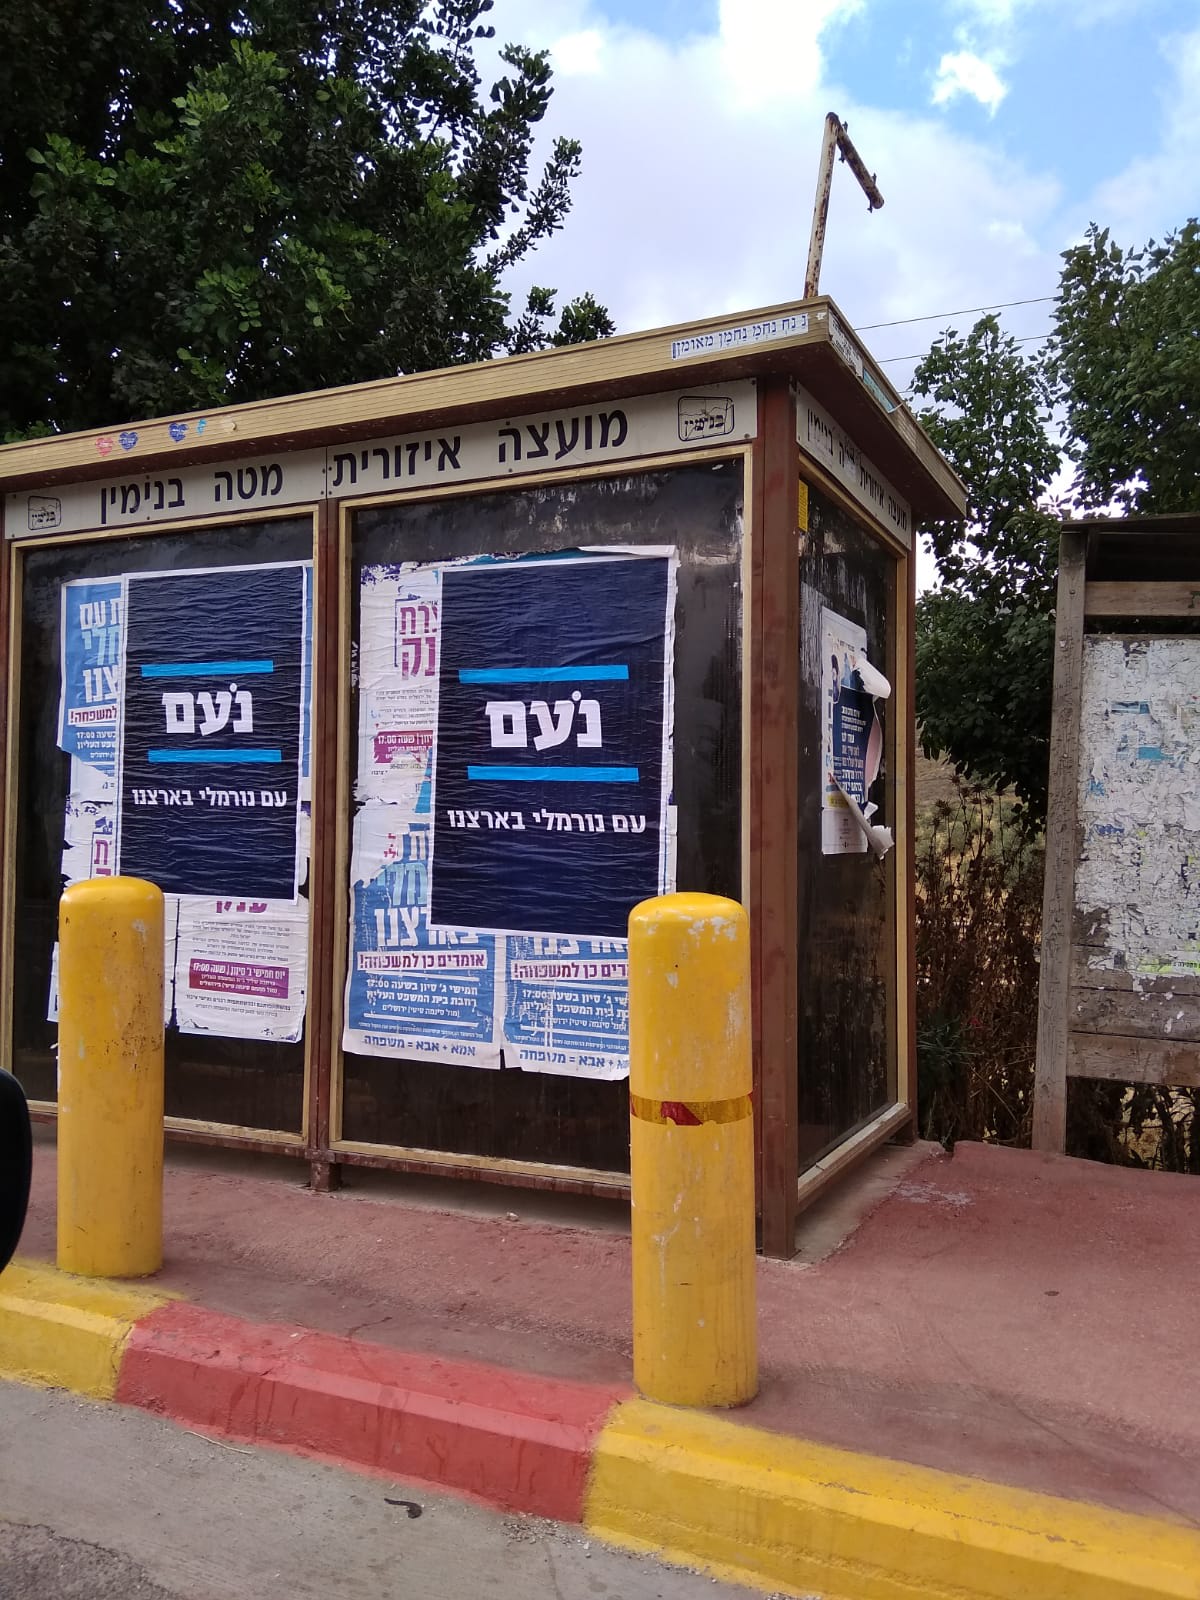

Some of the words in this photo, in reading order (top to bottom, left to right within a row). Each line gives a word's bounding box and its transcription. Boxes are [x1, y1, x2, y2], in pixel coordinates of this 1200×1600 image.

[498, 408, 629, 463] מועצה
[332, 435, 461, 487] איזורית
[214, 463, 284, 502] מטה
[100, 477, 186, 524] בנימין
[80, 600, 106, 630] עם
[132, 788, 194, 806] בארצנו
[199, 787, 256, 807] נורמלי
[261, 790, 288, 807] עם
[447, 809, 526, 830] בארצנו
[533, 808, 606, 832] נורמלי
[611, 814, 646, 833] עם
[422, 955, 435, 968] כן
[438, 953, 485, 967] אומרים
[583, 964, 597, 978] כן
[397, 993, 430, 1003] המשפט
[556, 1004, 593, 1015] המשפט
[364, 1035, 405, 1048] משפחה
[416, 1041, 439, 1052] אבא
[451, 1044, 476, 1056] אמא
[578, 1055, 605, 1067] אבא
